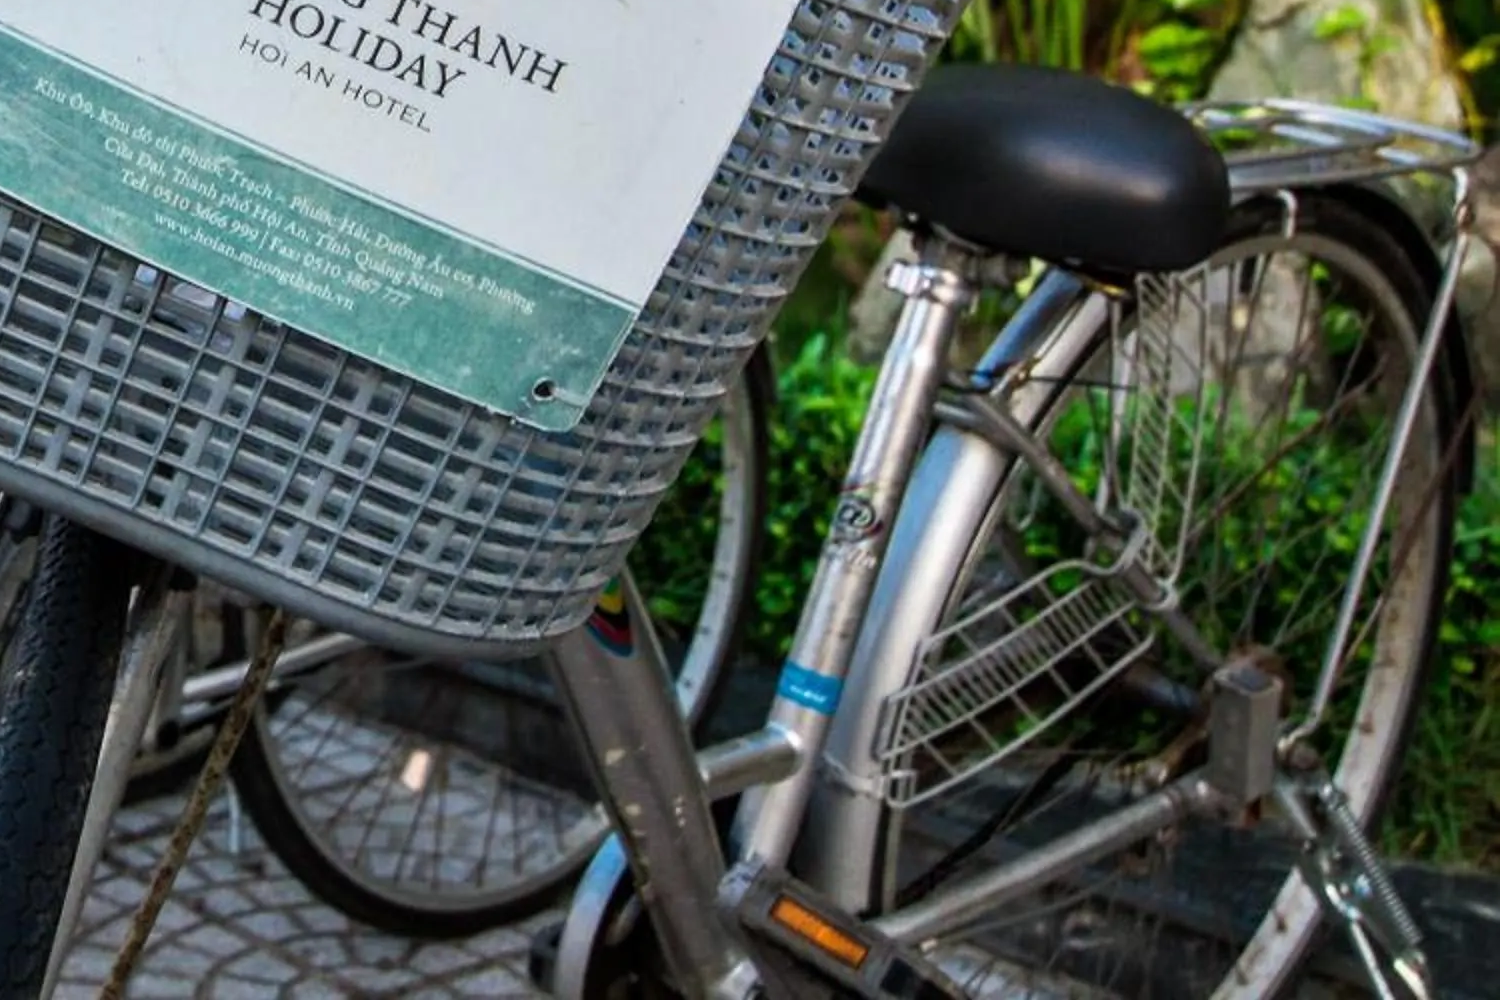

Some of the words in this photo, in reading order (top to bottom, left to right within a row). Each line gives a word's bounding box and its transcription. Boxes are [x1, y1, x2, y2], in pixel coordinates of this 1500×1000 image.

[34, 76, 68, 103] Khu
[96, 106, 132, 133] Khu
[297, 57, 335, 89] AN
[343, 78, 432, 133] HOTEL
[151, 183, 191, 211] 0510
[228, 219, 259, 243] 999
[406, 271, 446, 299] Nam
